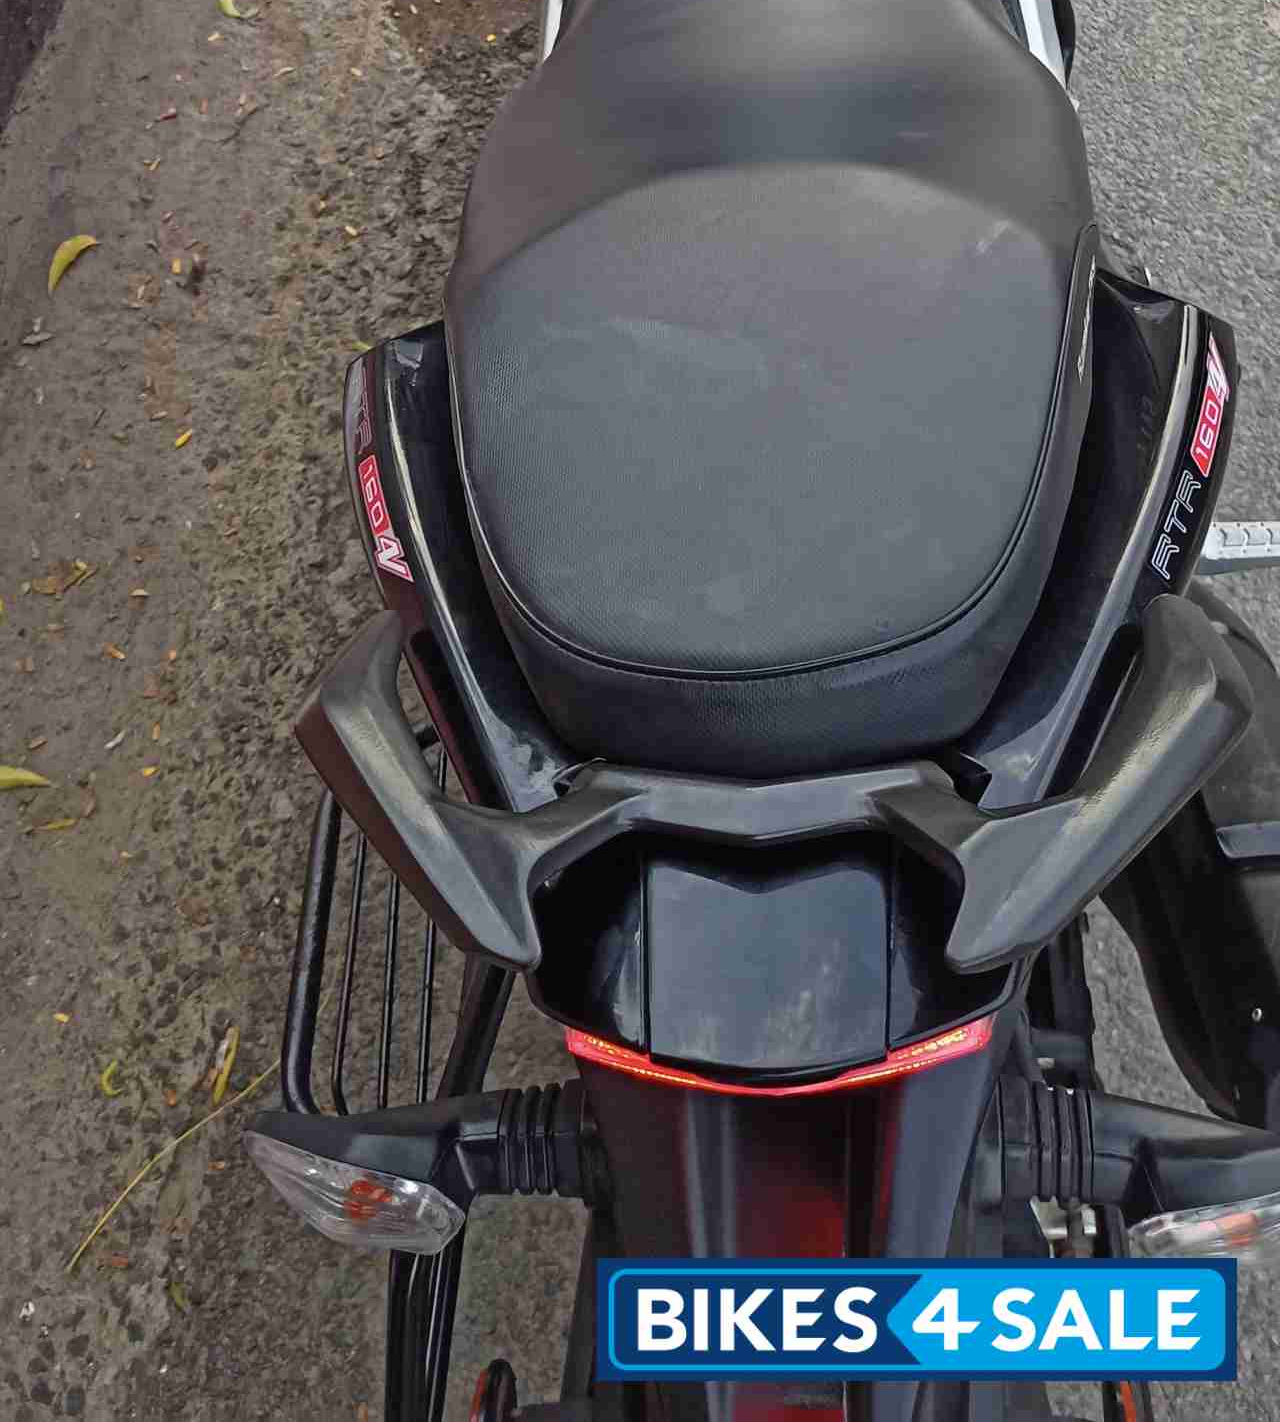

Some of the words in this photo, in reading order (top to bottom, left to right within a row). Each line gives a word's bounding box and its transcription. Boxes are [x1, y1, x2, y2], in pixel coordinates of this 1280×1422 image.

[362, 462, 384, 528] 160
[1152, 469, 1201, 580] RTR
[1194, 400, 1219, 459] 160
